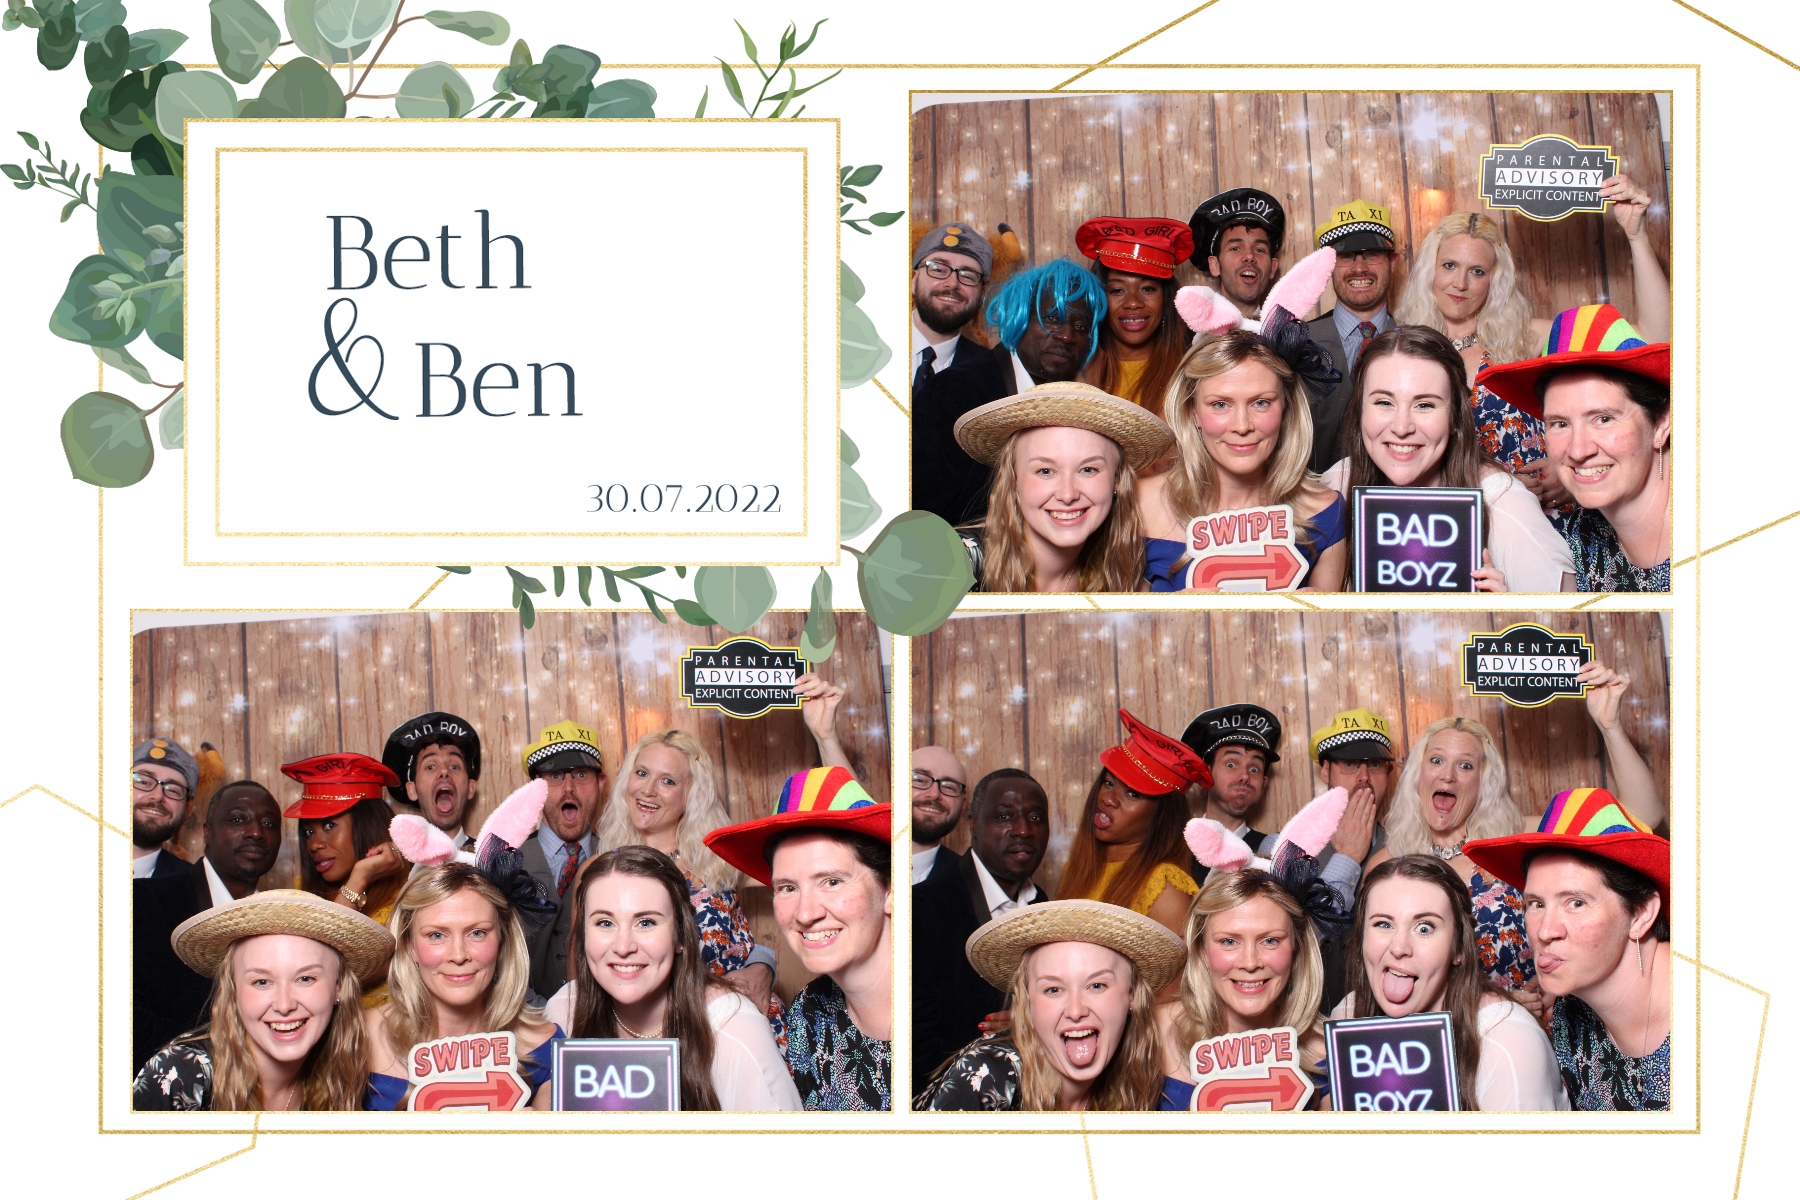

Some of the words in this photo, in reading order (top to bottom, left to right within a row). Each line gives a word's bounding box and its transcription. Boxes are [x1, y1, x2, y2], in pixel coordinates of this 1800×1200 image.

[1496, 155, 1604, 167] PARENTAL
[1495, 170, 1603, 185] ADVISORY
[1495, 189, 1544, 200] EXPLICIT
[1545, 190, 1600, 202] CONTENT
[1247, 197, 1274, 217] BOY
[1144, 225, 1176, 240] GIRL
[1192, 510, 1289, 551] SWIPE
[1376, 512, 1459, 547] BAD
[1377, 560, 1458, 588] BOYZ
[1477, 642, 1580, 654] PARENTAL
[695, 655, 795, 667] PARENTAL
[1477, 657, 1580, 671] ADVISORY
[695, 670, 796, 684] ADVISORY
[1478, 675, 1526, 687] EXPLICIT
[1527, 676, 1579, 688] CONTENT
[695, 688, 742, 699] EXPLICIT
[743, 688, 795, 699] CONTENT
[440, 721, 468, 737] BOY
[1247, 713, 1274, 734] BOY
[414, 1036, 511, 1077] SWIPE
[1195, 1031, 1293, 1075] SWIPE
[1349, 1040, 1432, 1078] BAD
[574, 1064, 656, 1098] BAD
[1354, 1088, 1435, 1111] BOYZ
